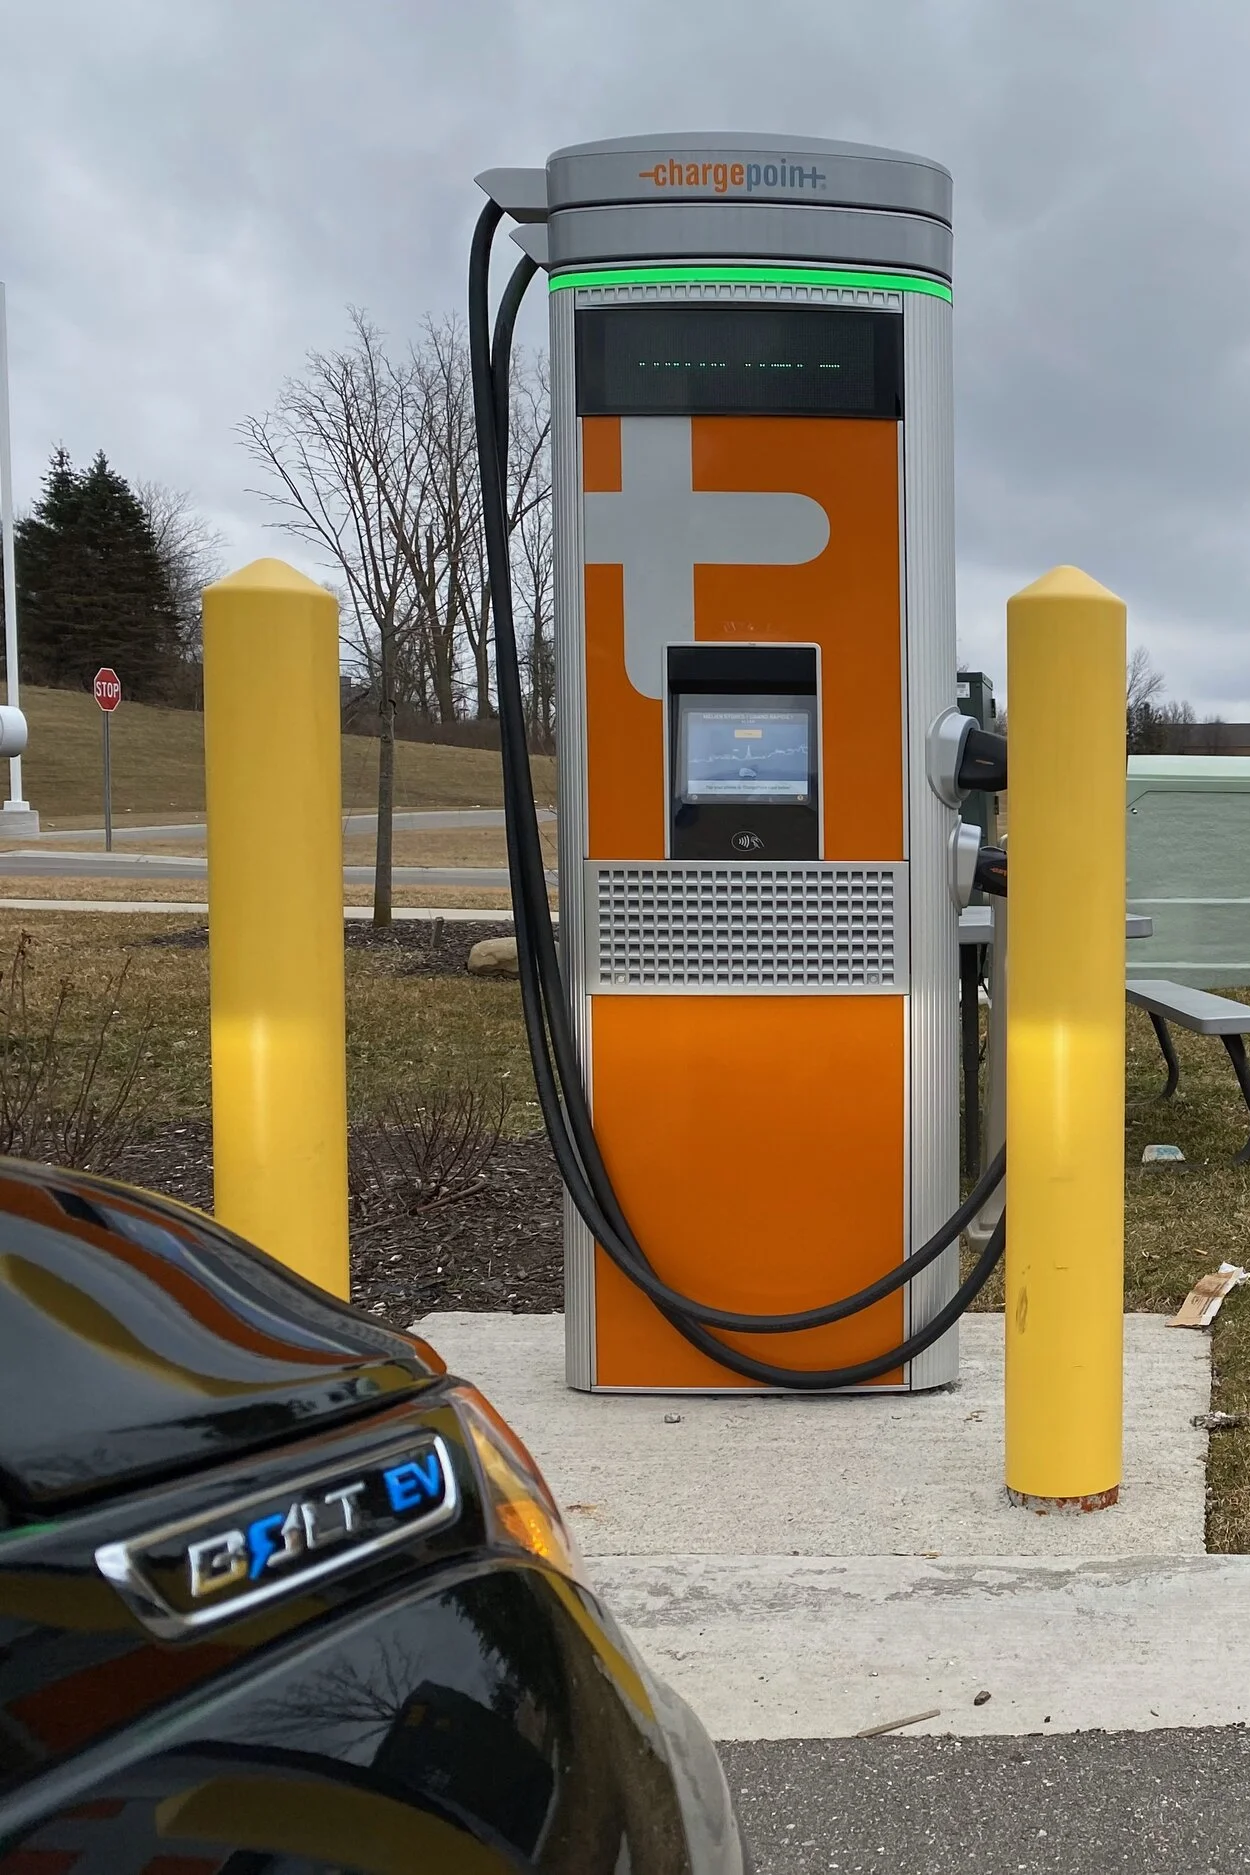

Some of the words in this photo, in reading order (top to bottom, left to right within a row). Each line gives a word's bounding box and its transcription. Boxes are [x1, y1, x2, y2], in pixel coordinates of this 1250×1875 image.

[96, 681, 119, 698] STOP
[187, 1482, 367, 1598] BOLT
[382, 1453, 441, 1512] EV
